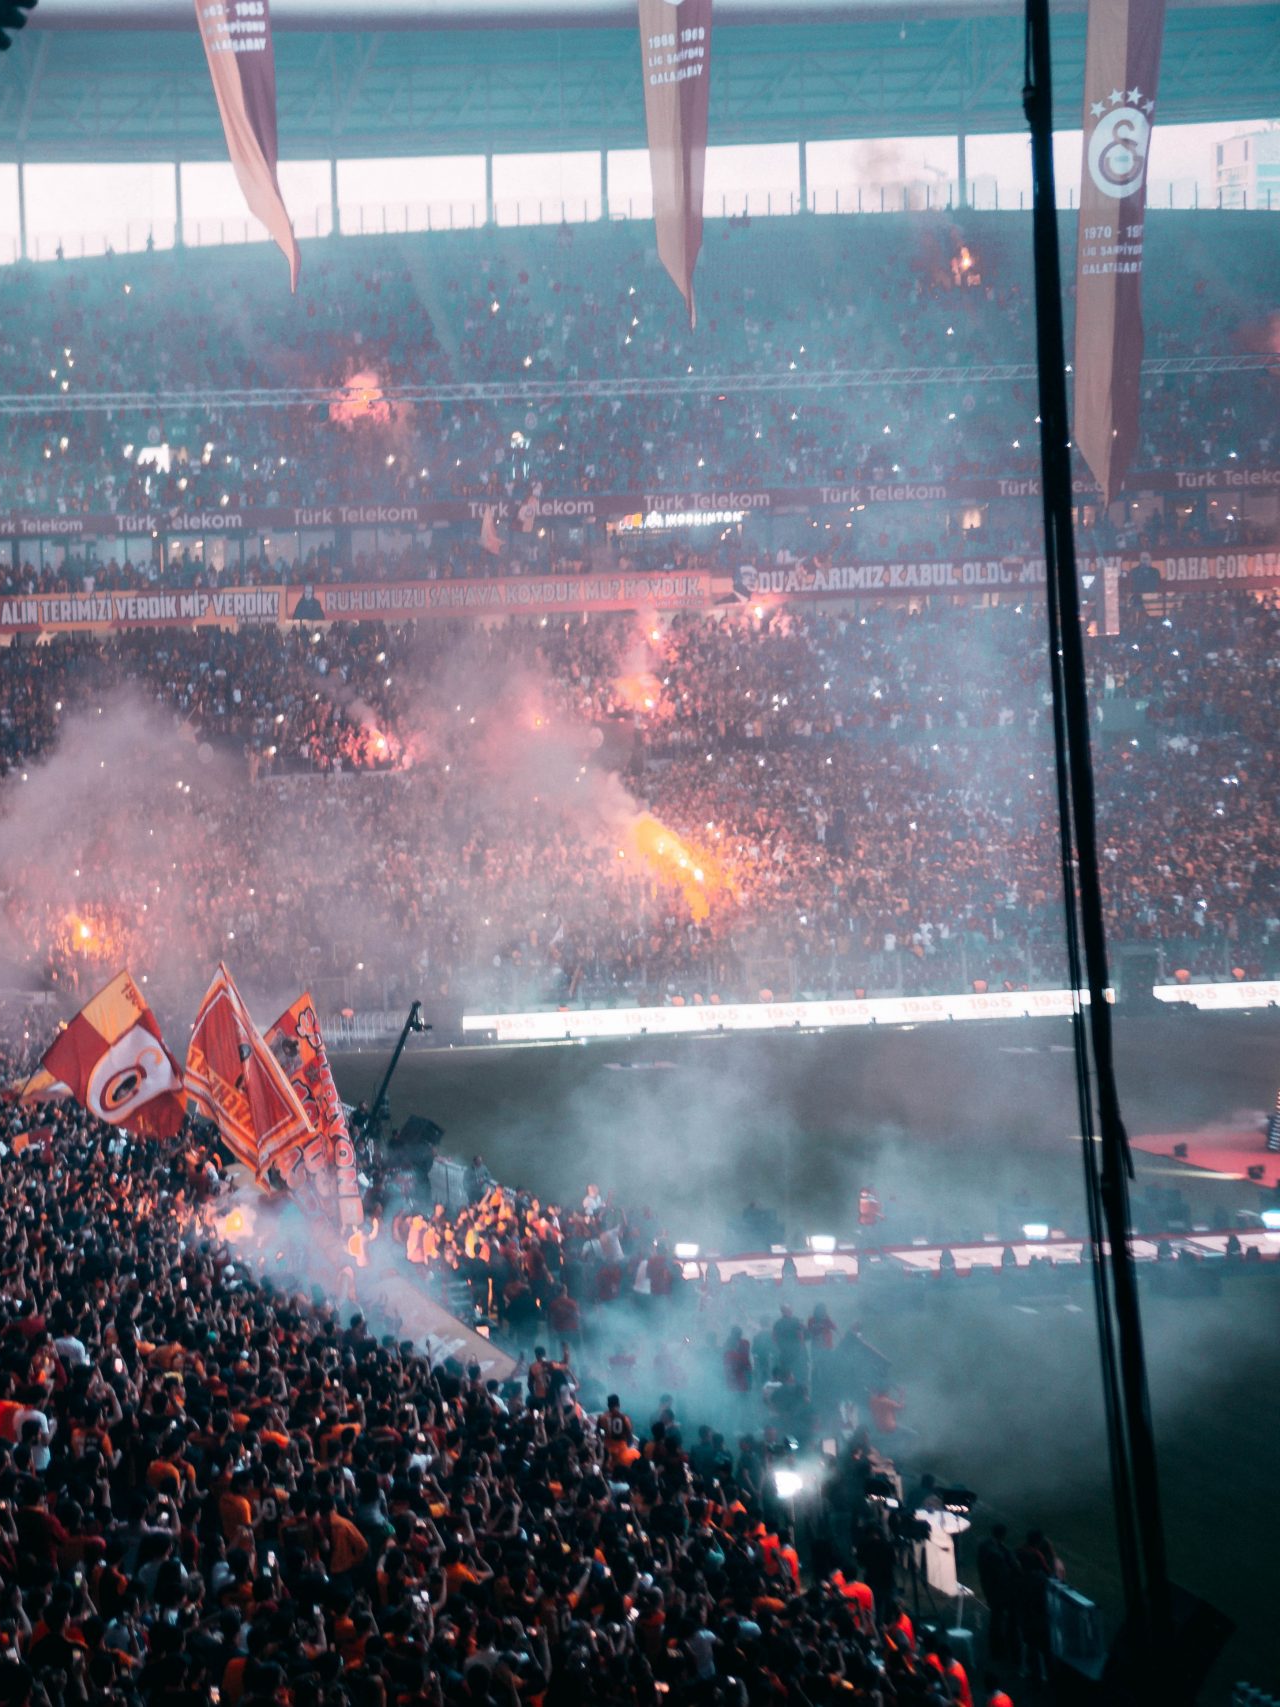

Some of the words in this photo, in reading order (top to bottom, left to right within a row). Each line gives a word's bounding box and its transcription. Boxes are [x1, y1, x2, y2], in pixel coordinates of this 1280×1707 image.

[997, 479, 1040, 496] Türk
[1175, 472, 1218, 488] Türk
[644, 495, 685, 511] Türk
[690, 491, 770, 509] Telekom
[820, 486, 861, 504] Türk
[867, 484, 946, 502] Telekom
[19, 517, 83, 534] Telekom
[116, 514, 157, 532] Türk
[171, 512, 243, 531] elekom
[293, 508, 333, 526] Türk
[338, 505, 418, 524] Telekom
[758, 564, 885, 594] DUALARIMIZ
[889, 563, 959, 587] KABUL
[1165, 556, 1209, 581] DAHA
[1, 600, 38, 625] ALIN
[41, 590, 113, 623] TERİMİZİ
[115, 587, 178, 621] VERDİK
[179, 588, 210, 618] Mİ?
[211, 587, 280, 618] VERDİK!
[325, 588, 426, 613] RUHUMUZU
[429, 584, 501, 610] SAHAYA
[505, 582, 580, 605] KOYDUK
